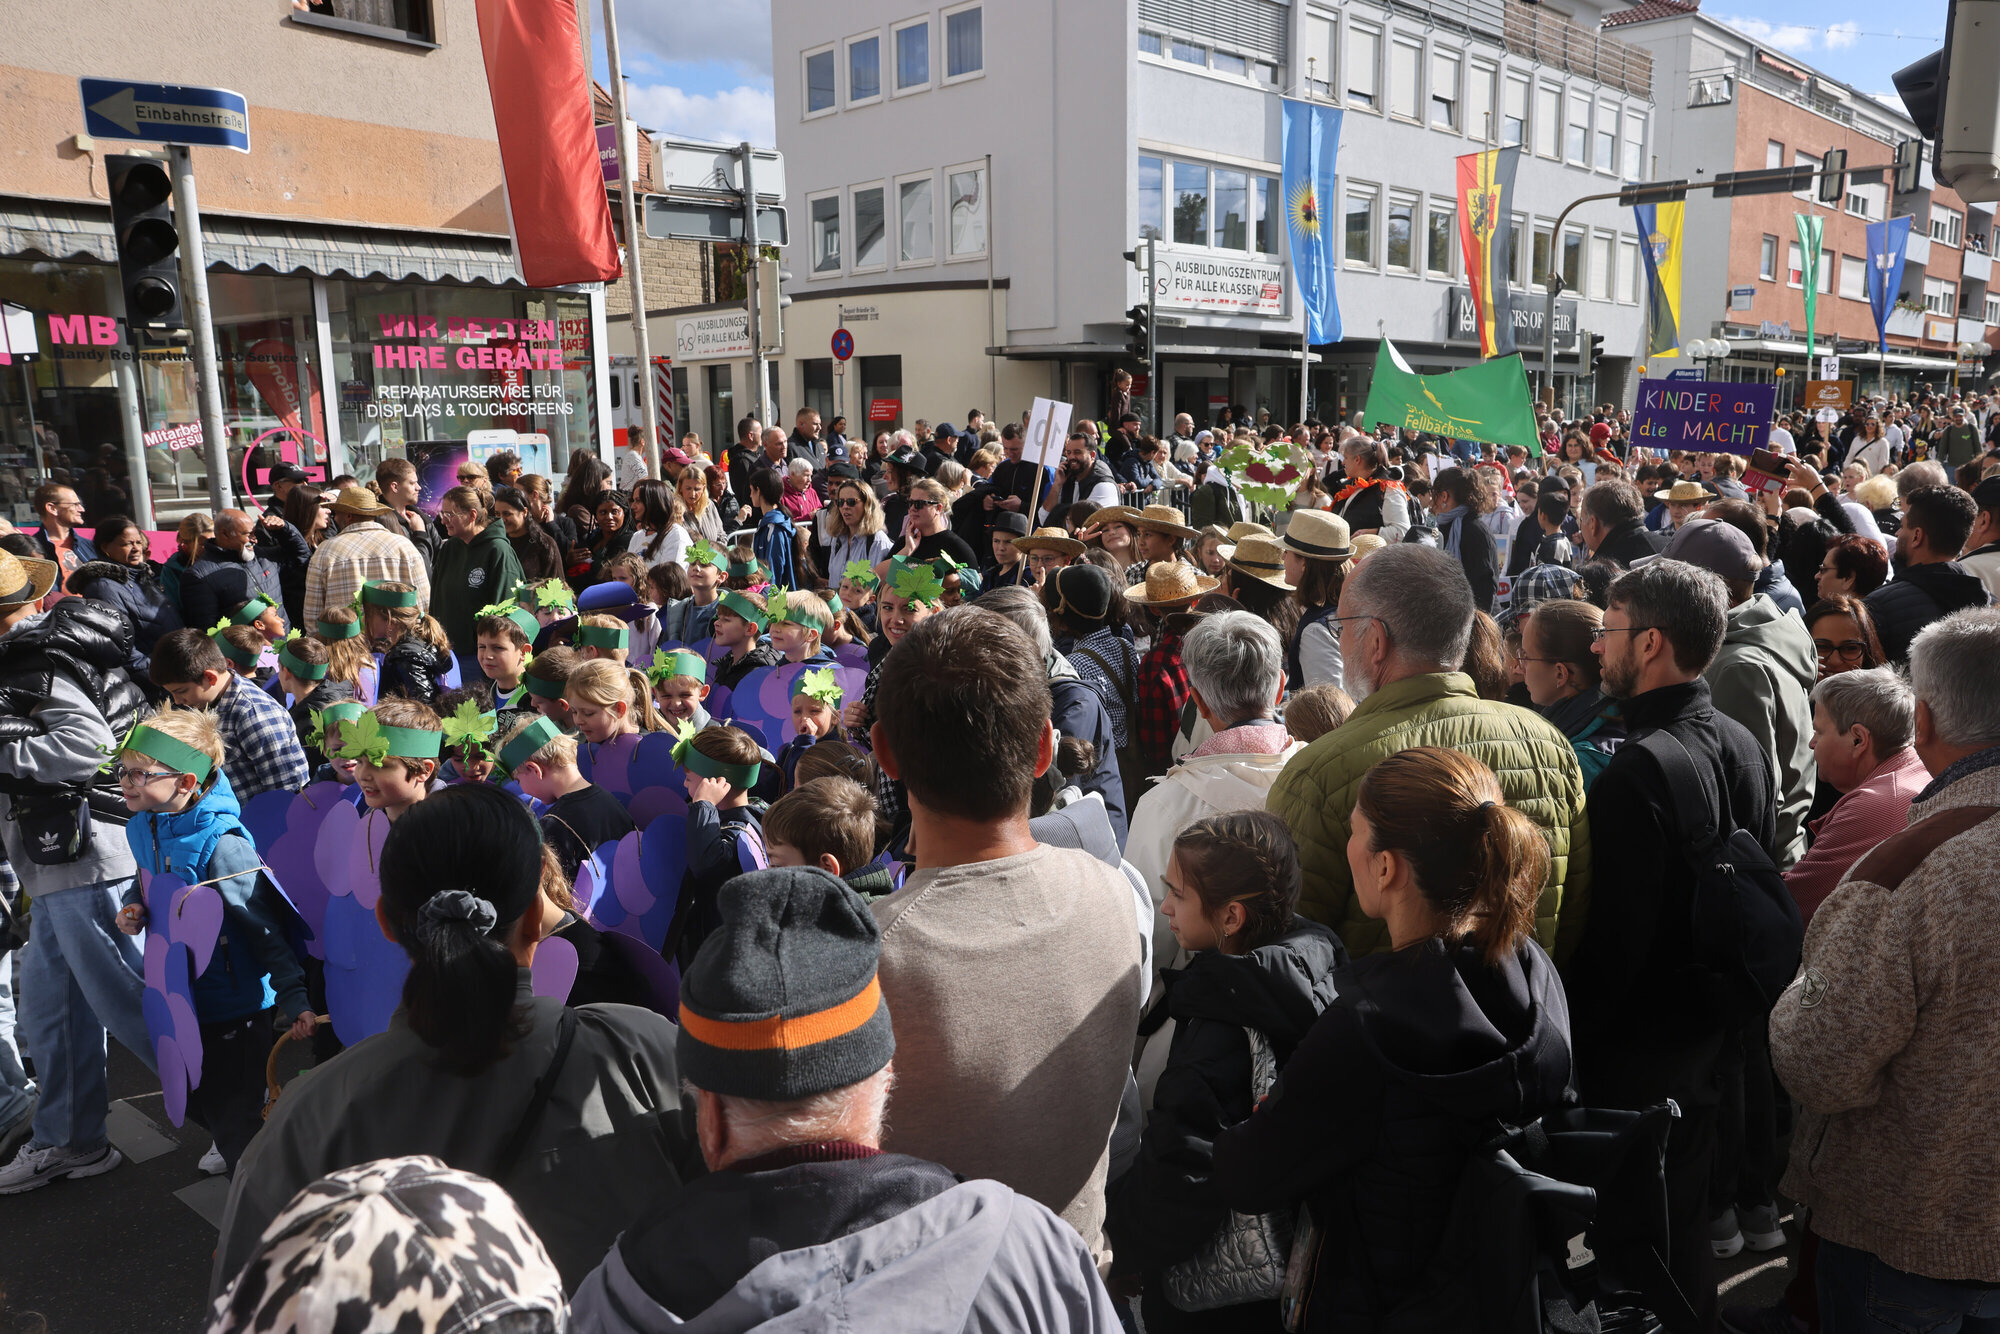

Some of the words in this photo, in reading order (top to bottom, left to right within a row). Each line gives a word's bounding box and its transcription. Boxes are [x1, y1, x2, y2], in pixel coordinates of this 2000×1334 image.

[135, 105, 242, 129] Einbahnstraße
[1175, 261, 1281, 283] AUSBILDUNGSZENTRUM
[1175, 276, 1193, 291] FÜR
[1195, 279, 1218, 293] ALLE
[1219, 281, 1259, 296] KLASSEN
[378, 313, 439, 338] WIR
[447, 316, 555, 341] RETTEN
[697, 315, 748, 332] AUSBILDUNGSZ
[1530, 311, 1545, 329] OF
[697, 333, 710, 345] FÜR
[711, 332, 727, 343] ALLE
[728, 331, 749, 342] KLASS
[247, 351, 299, 363] Service
[374, 345, 447, 369] IHRE
[456, 342, 564, 370] GERÄTE
[1823, 363, 1837, 373] 12
[378, 385, 531, 399] REPARATURSERVICE
[534, 383, 562, 398] FÜR
[367, 403, 441, 418] DISPLAYS
[445, 403, 455, 417] &
[458, 402, 574, 417] TOUCHSCREENS
[1644, 389, 1722, 413] KINDER
[1733, 401, 1756, 415] an
[1404, 414, 1455, 436] Fellbach
[1639, 417, 1668, 437] die
[1682, 420, 1759, 445] MACHT
[41, 844, 60, 853] adidas
[1571, 1250, 1590, 1263] BOSS
